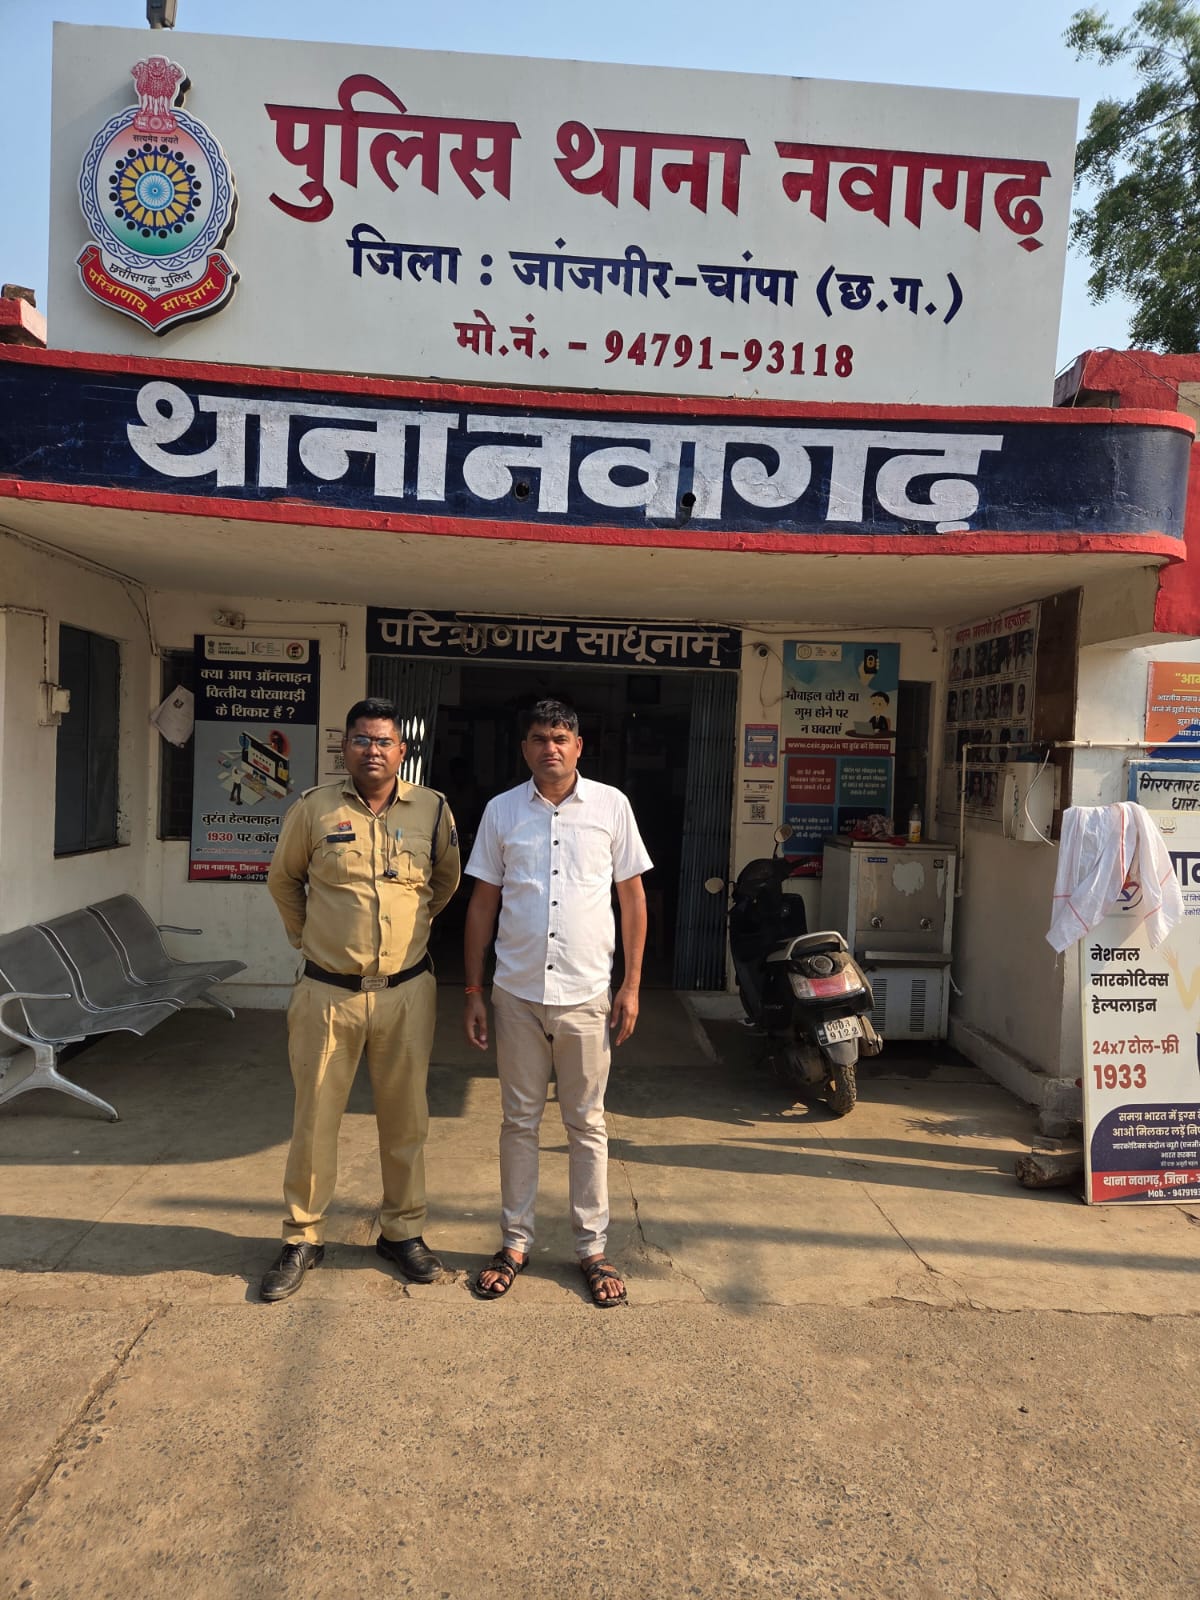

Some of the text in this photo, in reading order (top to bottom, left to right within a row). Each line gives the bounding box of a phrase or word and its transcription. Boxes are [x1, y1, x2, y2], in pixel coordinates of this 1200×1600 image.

[132, 134, 179, 144] सत्यमेव जयते
[265, 73, 1051, 253] पुलिस थाना नवागढ़
[109, 263, 193, 288] छत्तीसगढ़ पुलिस
[346, 223, 462, 285] जिला
[509, 237, 798, 308] जांजगीर-चांपा
[816, 264, 964, 325] (छ.ग.)
[88, 267, 220, 312] परित्राणाय साधूनाम्
[453, 309, 550, 360] मो.नं.
[604, 329, 854, 378] 94791-93118
[126, 380, 1004, 534] थाना नवागढ़
[576, 625, 730, 666] साधूनाम्
[200, 668, 312, 685] क्या आप ऑनलाइन
[206, 684, 305, 702] वित्तीय धोखाधड़ी
[785, 687, 859, 703] मोबाइल चोरी या
[215, 703, 228, 716] के
[231, 703, 270, 718] शिकार
[273, 705, 283, 719] हैं
[793, 706, 849, 720] गुम होने पर
[801, 723, 842, 735] न घबराएं
[202, 811, 280, 827] तुरंत हेल्पलाइन
[207, 832, 279, 843] 1930 पर कॉल
[1090, 944, 1140, 961] नेशनल
[1091, 968, 1169, 987] नारकोटिक्स
[1091, 994, 1157, 1014] हेल्पलाइन
[830, 1026, 859, 1040] 9122
[1093, 1034, 1179, 1055] 24x7 टोल-फ्री
[1093, 1064, 1147, 1090] 1933
[1118, 1112, 1143, 1121] समग्र
[1144, 1111, 1167, 1121] भारत
[1167, 1108, 1177, 1120] में
[1177, 1111, 1196, 1121] ड्रग्स
[1112, 1125, 1134, 1137] आओ
[1135, 1124, 1170, 1136] मिलकर
[1170, 1124, 1186, 1138] लड़ें
[1103, 1175, 1127, 1186] थाना
[1127, 1174, 1162, 1187] नवागढ़,
[1163, 1172, 1189, 1185] जिला
[1147, 1188, 1166, 1198] Mob.
